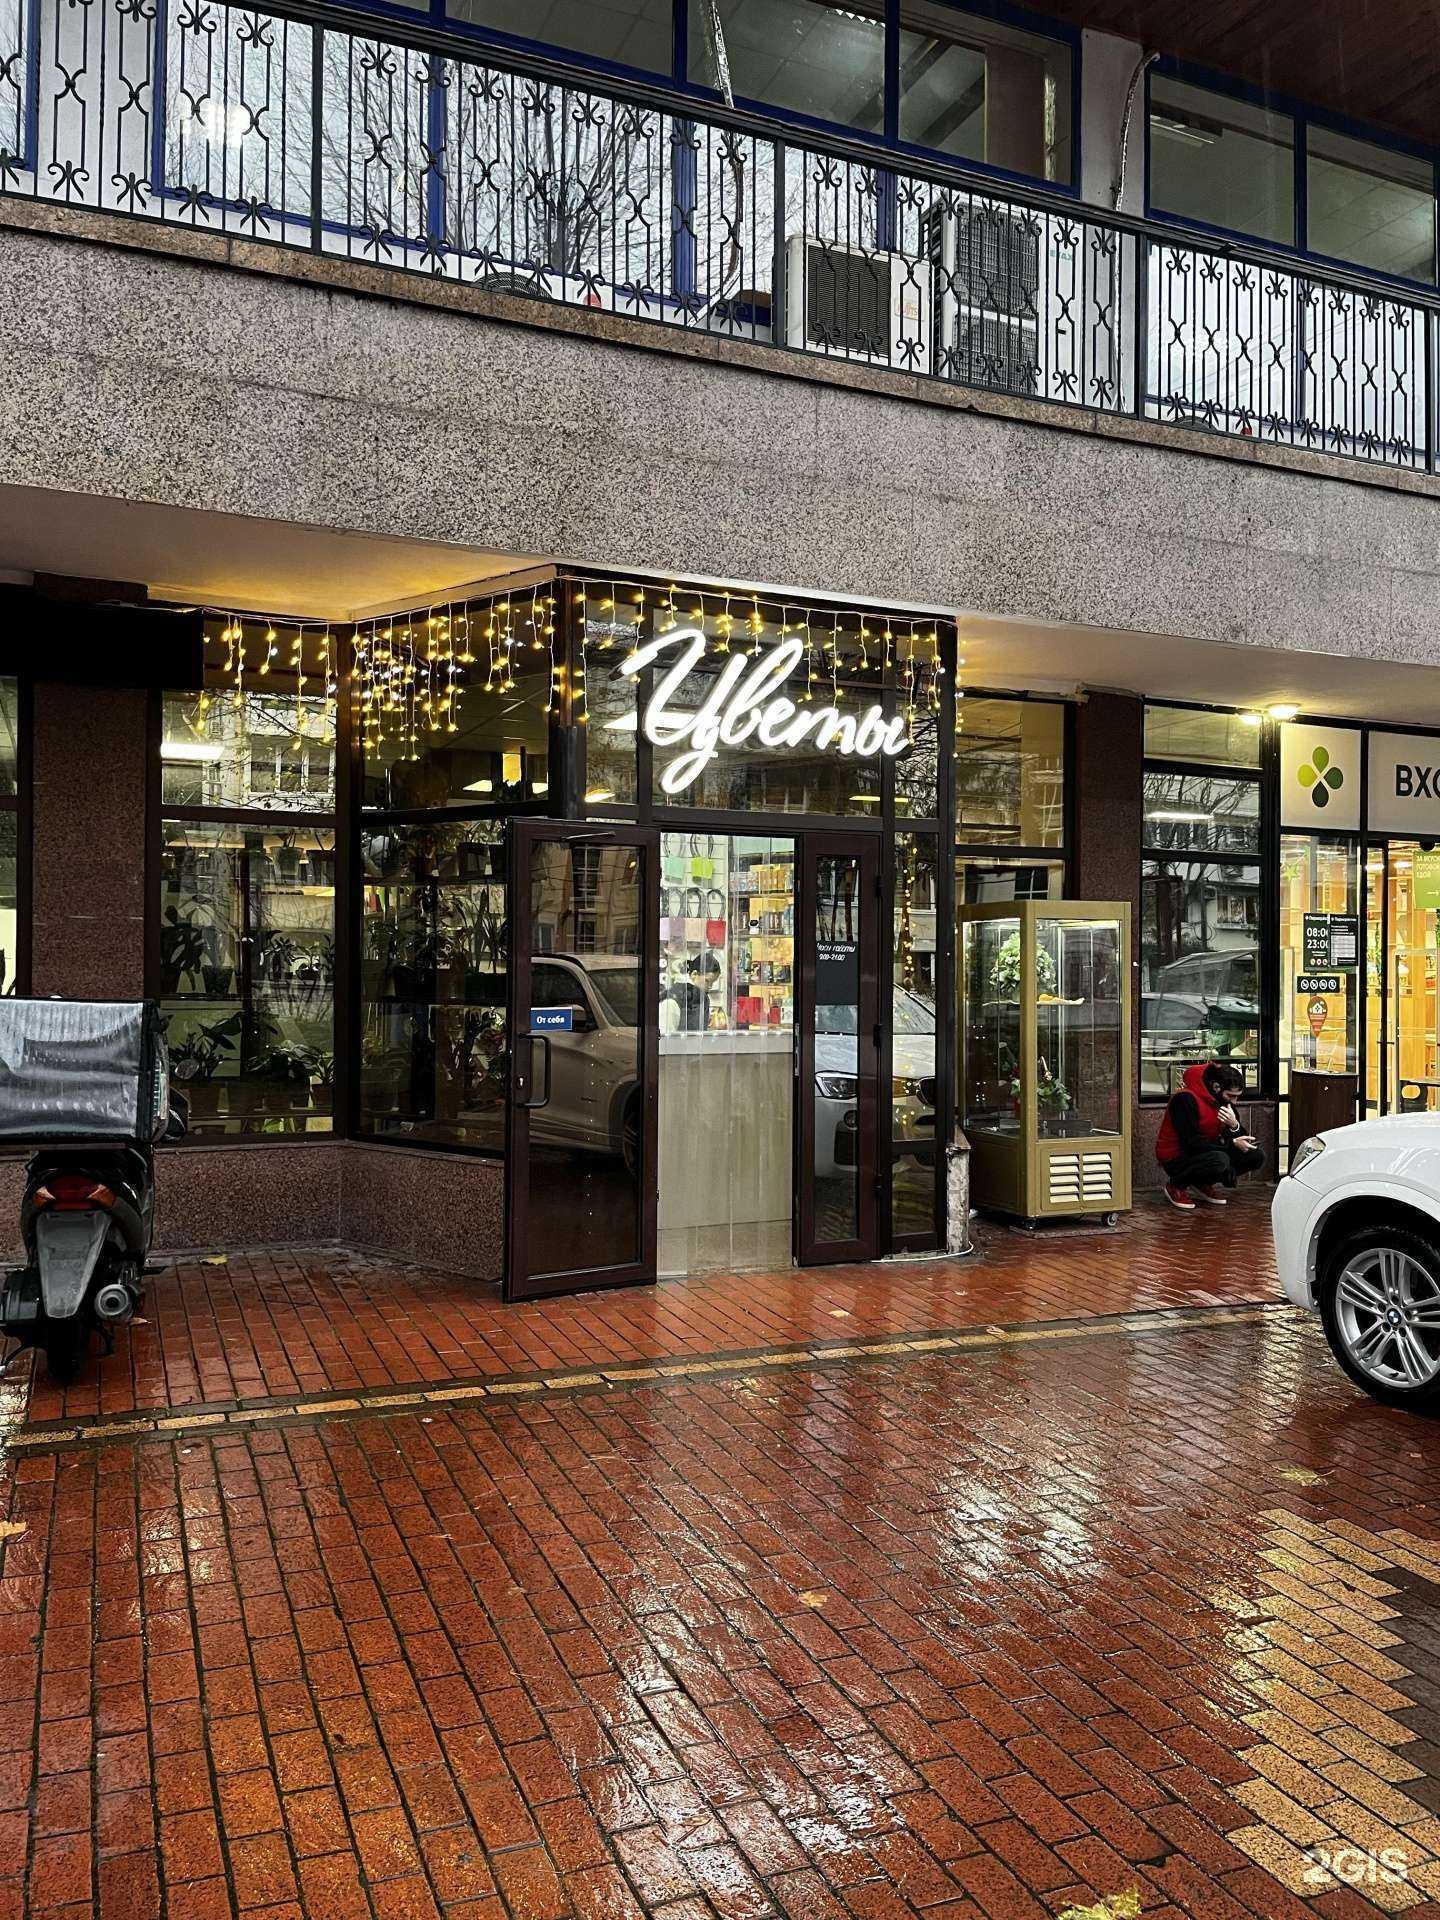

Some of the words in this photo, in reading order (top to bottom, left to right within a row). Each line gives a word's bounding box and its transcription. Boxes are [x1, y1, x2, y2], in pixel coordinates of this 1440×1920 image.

[612, 628, 909, 794] Цветы
[536, 1016, 546, 1024] От
[547, 1014, 565, 1024] себя
